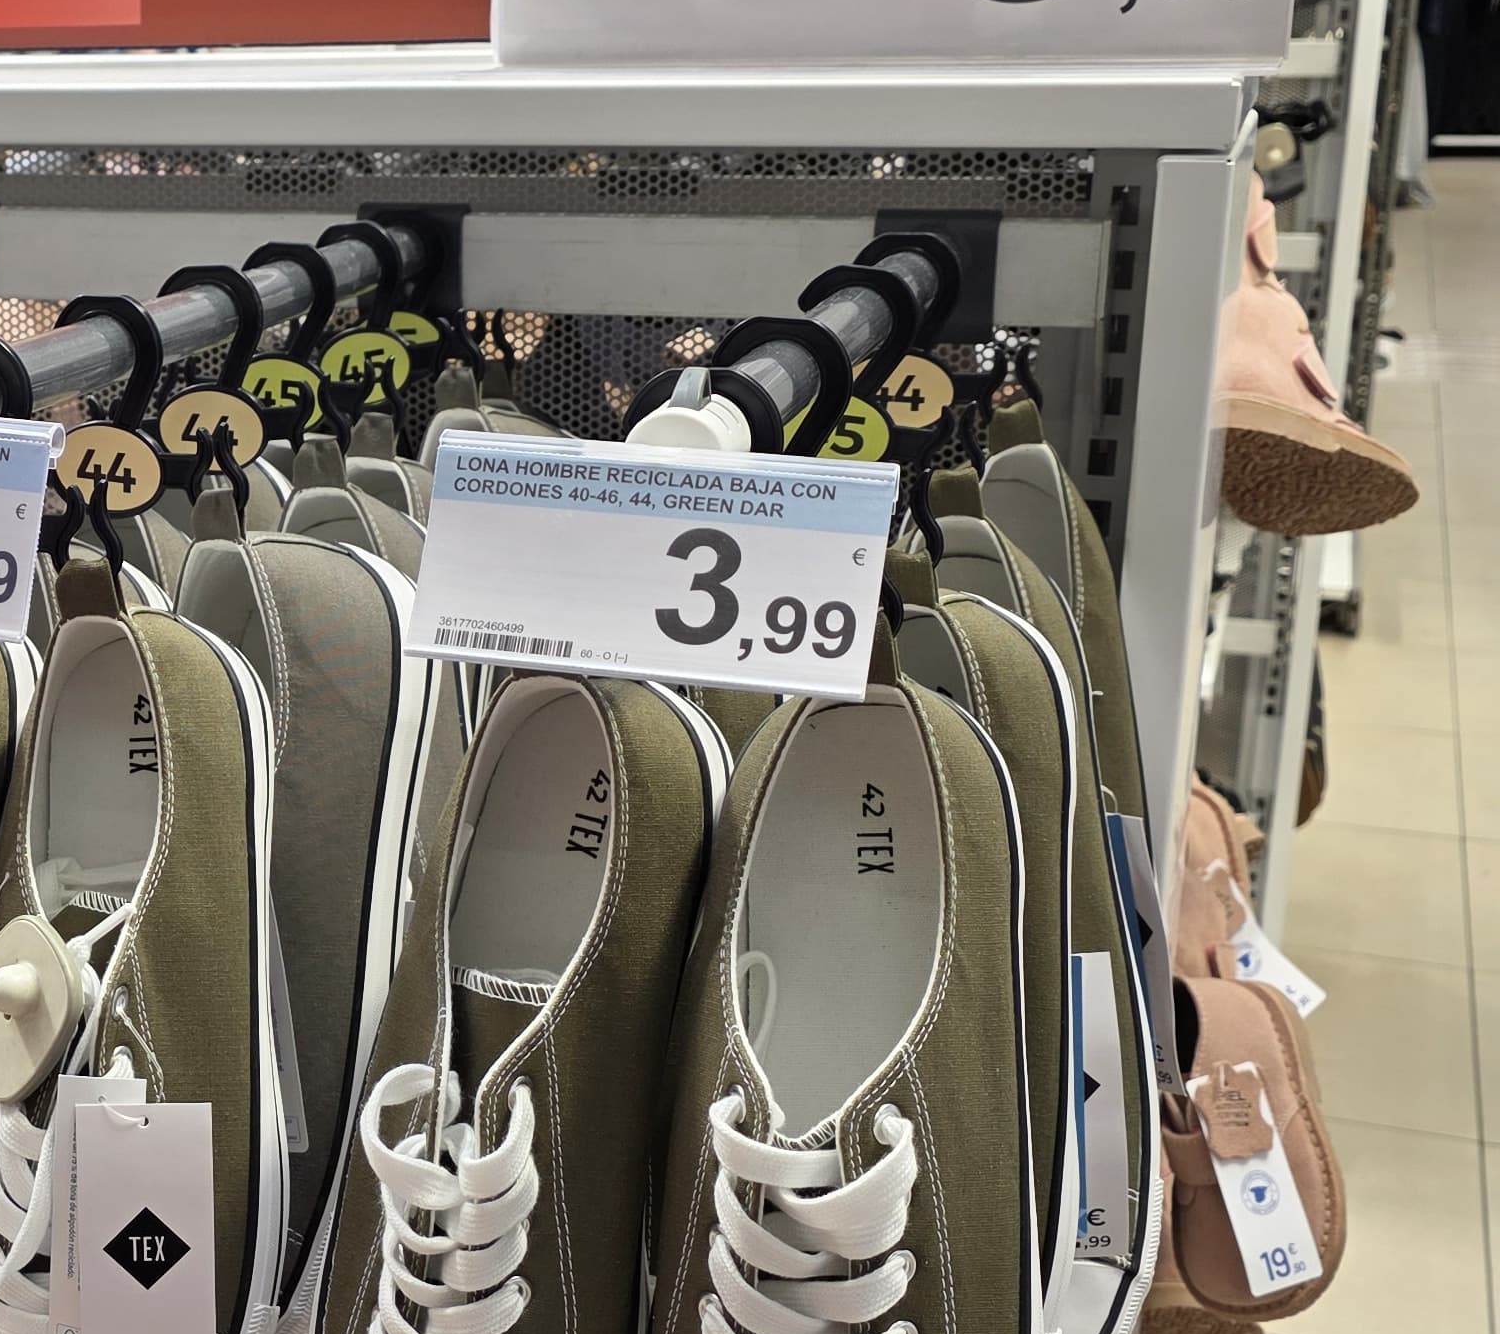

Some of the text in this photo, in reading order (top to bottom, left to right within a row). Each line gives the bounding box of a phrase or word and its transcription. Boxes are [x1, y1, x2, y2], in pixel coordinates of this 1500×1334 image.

[829, 414, 866, 456] 5
[77, 448, 136, 495] 44
[456, 455, 837, 502] LONA HOMBRE RECICLADA BAJA CON
[15, 503, 27, 520] €
[453, 477, 785, 518] CORDONES 40-46, 44, GREEN DAR
[852, 547, 868, 567] €
[438, 615, 524, 634] 3617702460499
[580, 648, 593, 660] 60
[128, 693, 159, 776] 42 TEX
[564, 768, 612, 860] 42 TEX
[857, 783, 895, 874] 42 TEX
[1087, 1208, 1106, 1226] €
[129, 1236, 165, 1262] TEX
